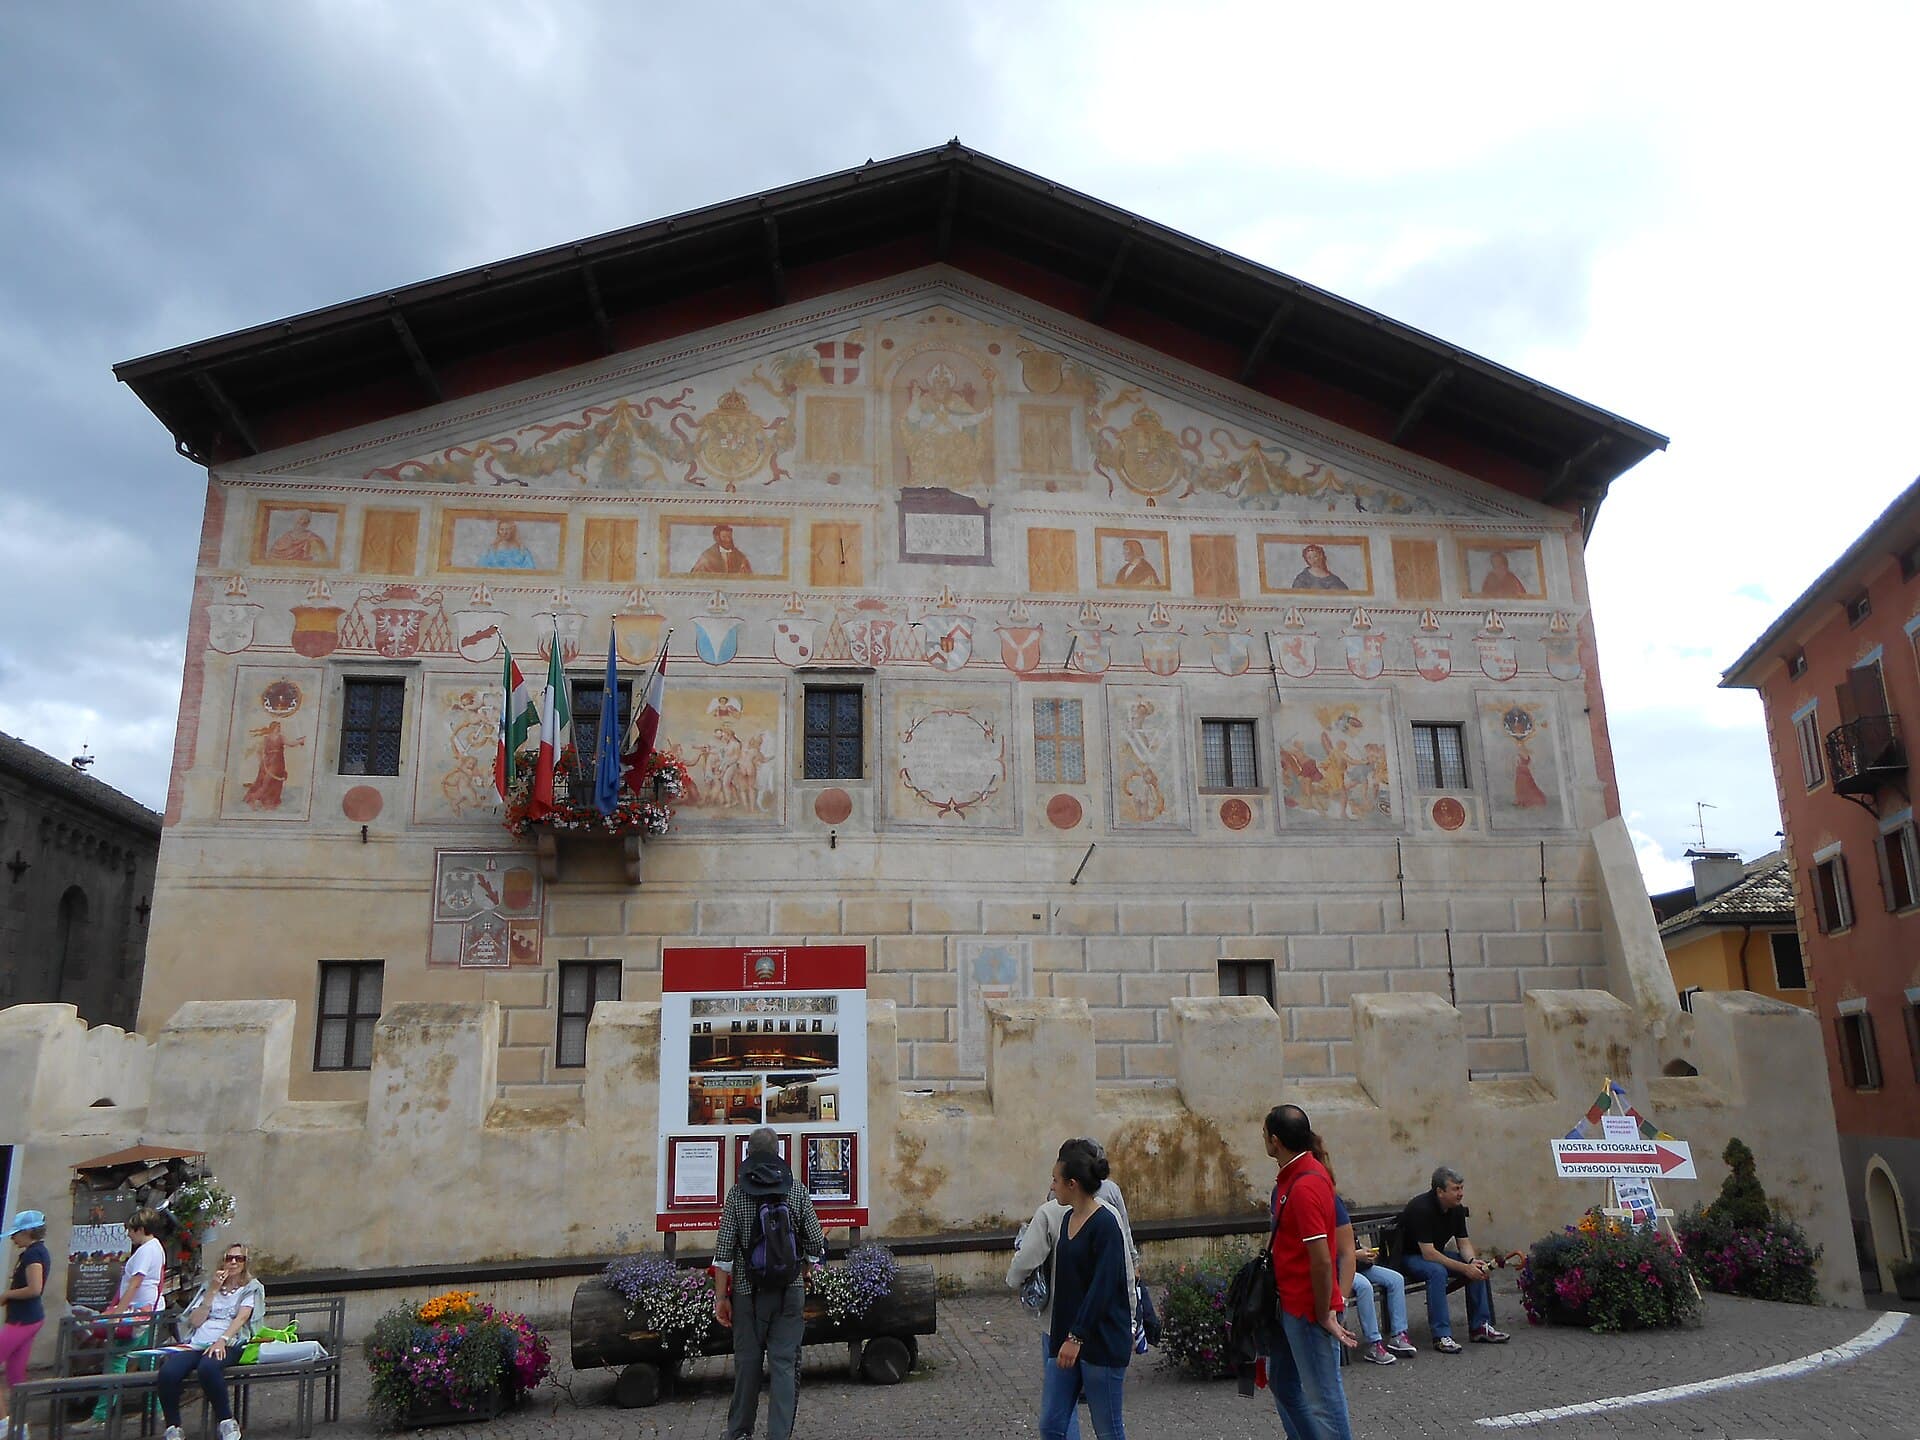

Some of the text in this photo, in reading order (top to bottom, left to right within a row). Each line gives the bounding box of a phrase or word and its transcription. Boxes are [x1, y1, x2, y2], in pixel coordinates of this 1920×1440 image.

[1558, 1143, 1654, 1152] MOSTRA FOTOGRAFICA
[1562, 1165, 1658, 1173] MOSTRA FOTOGRAFICA
